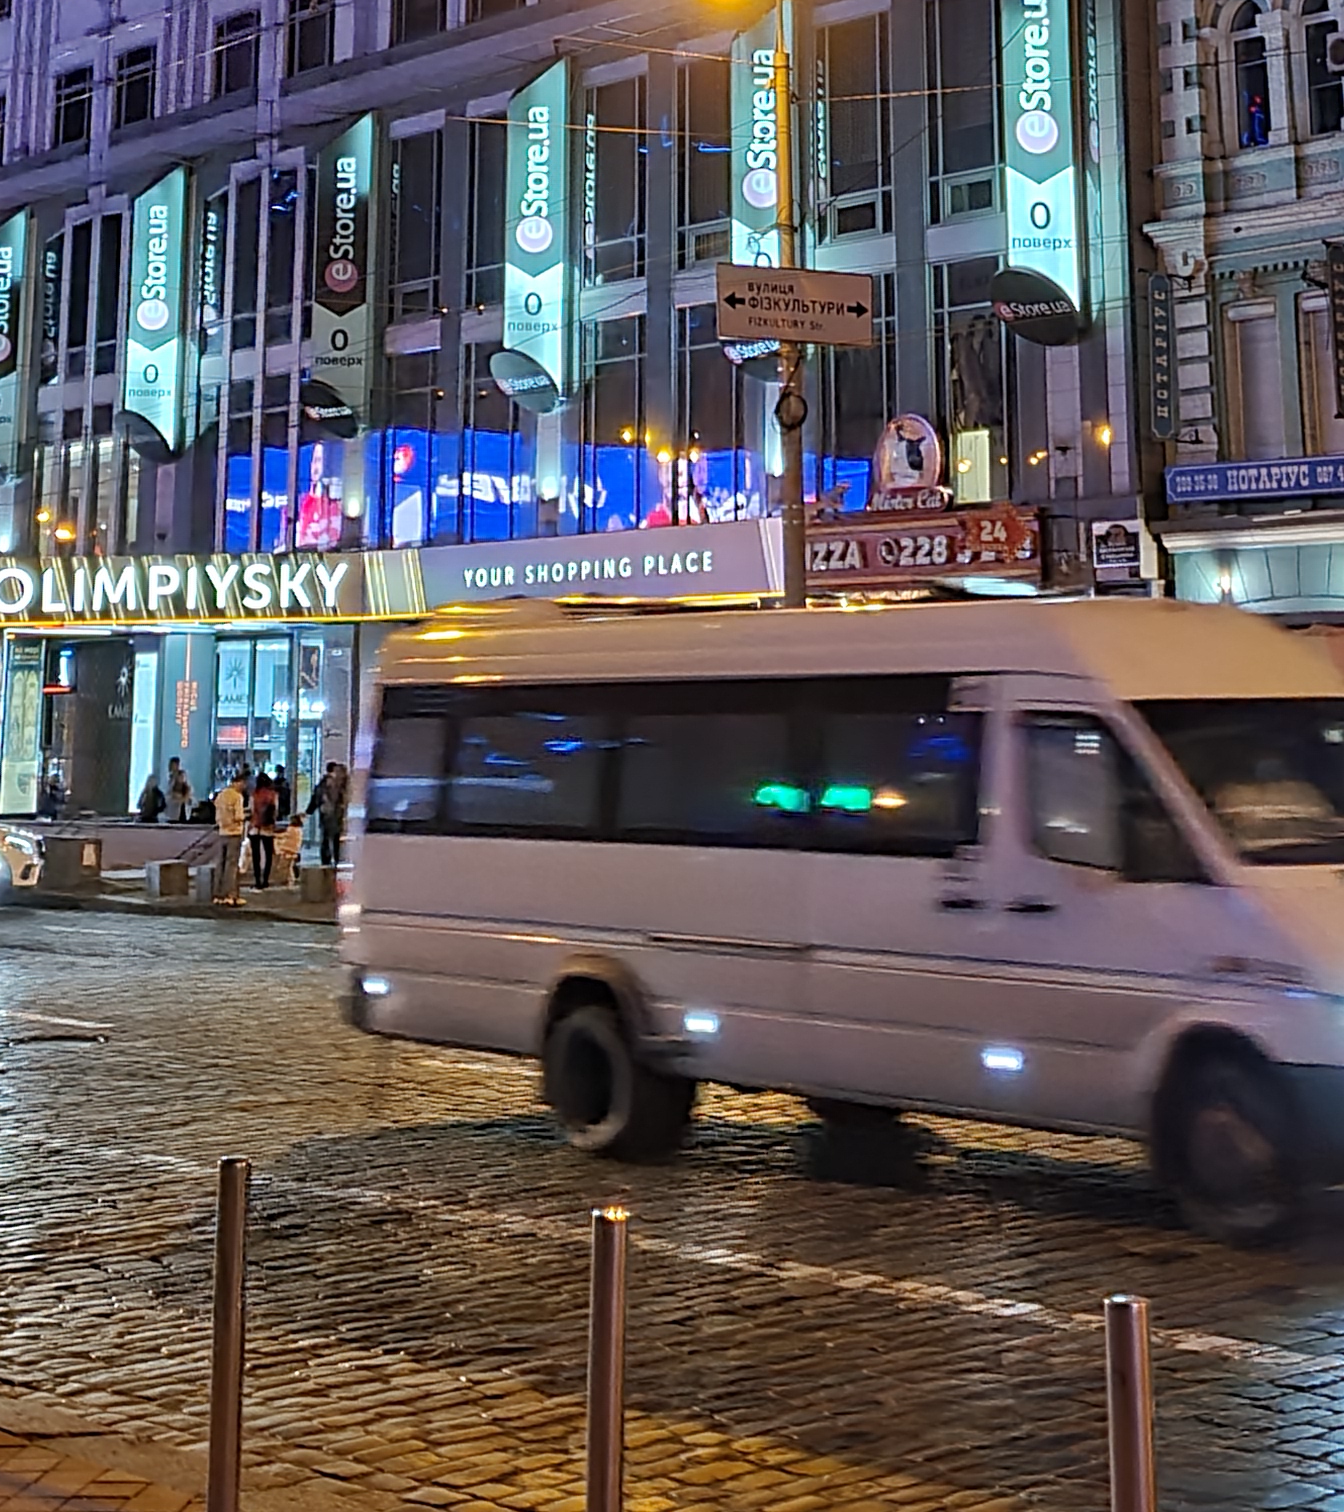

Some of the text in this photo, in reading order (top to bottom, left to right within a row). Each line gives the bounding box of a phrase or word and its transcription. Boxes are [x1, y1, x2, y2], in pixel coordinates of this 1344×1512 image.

[520, 105, 550, 242] eStore.ua
[329, 156, 357, 281] eStore.ua
[1012, 237, 1072, 251] поверх
[141, 204, 169, 318] eStore.ua
[747, 281, 794, 295] вулиця
[748, 296, 845, 316] ФІЗКУЛЬТУРИ
[508, 321, 558, 333] поверх
[748, 317, 825, 331] FIZKULTURY Str.
[314, 356, 363, 367] поверх
[1153, 289, 1169, 418] НОТАРІУС
[128, 388, 172, 399] поверх
[1226, 465, 1309, 491] НОТАРІУС
[872, 489, 942, 511] Mister Cat
[980, 520, 1007, 542] 24
[805, 540, 862, 572] IZZA
[900, 535, 948, 568] 228
[463, 551, 713, 588] YOUR SHOPPING PLACE
